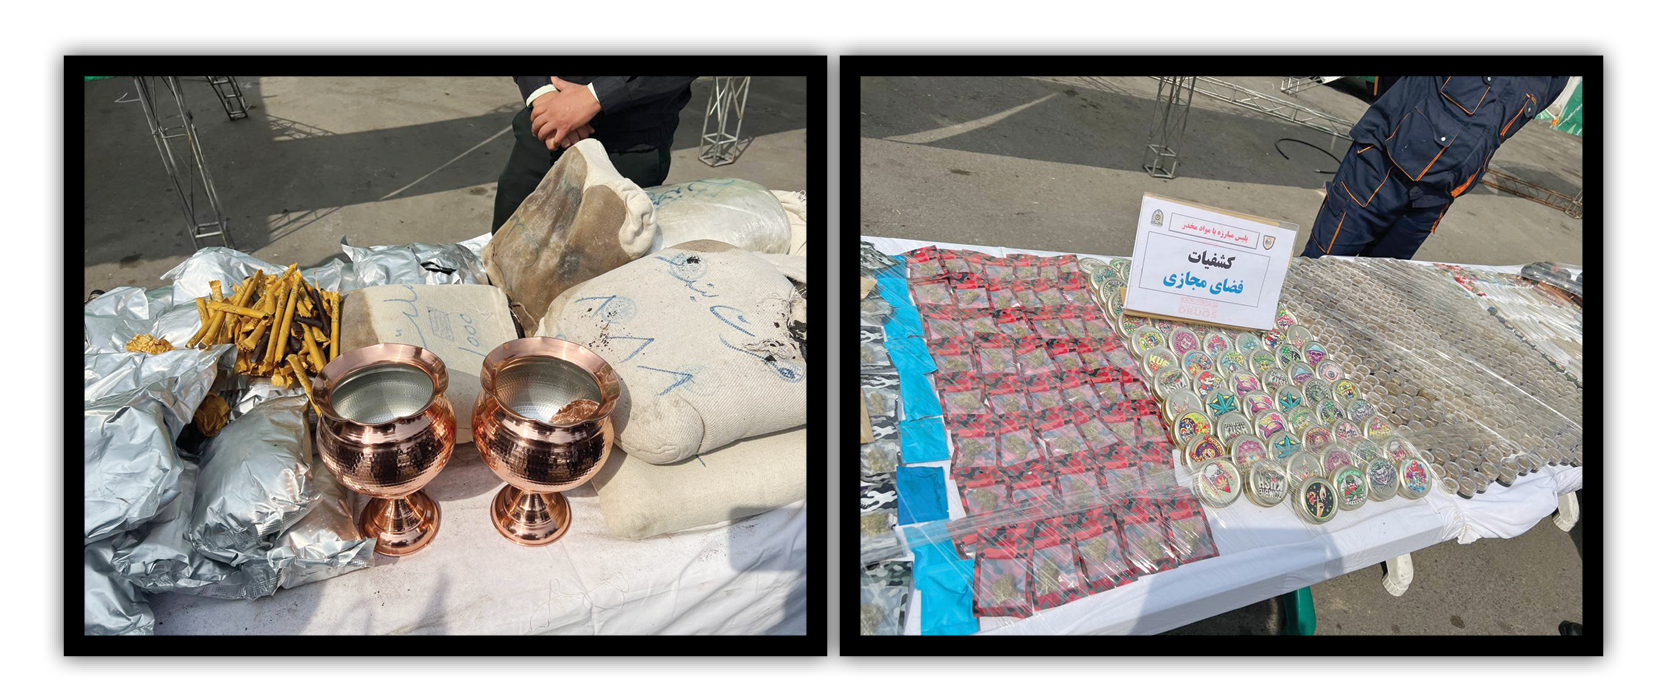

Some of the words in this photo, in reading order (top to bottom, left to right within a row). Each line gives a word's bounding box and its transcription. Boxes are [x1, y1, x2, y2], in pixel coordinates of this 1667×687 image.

[1182, 222, 1198, 230] مخدر
[1199, 225, 1211, 234] مواد
[1212, 227, 1217, 236] با
[1217, 230, 1234, 239] مبارزه
[1188, 250, 1236, 269] کشفیات
[1163, 272, 1207, 290] مجازی
[1210, 278, 1243, 294] فضای
[1178, 306, 1217, 319] DRUGS
